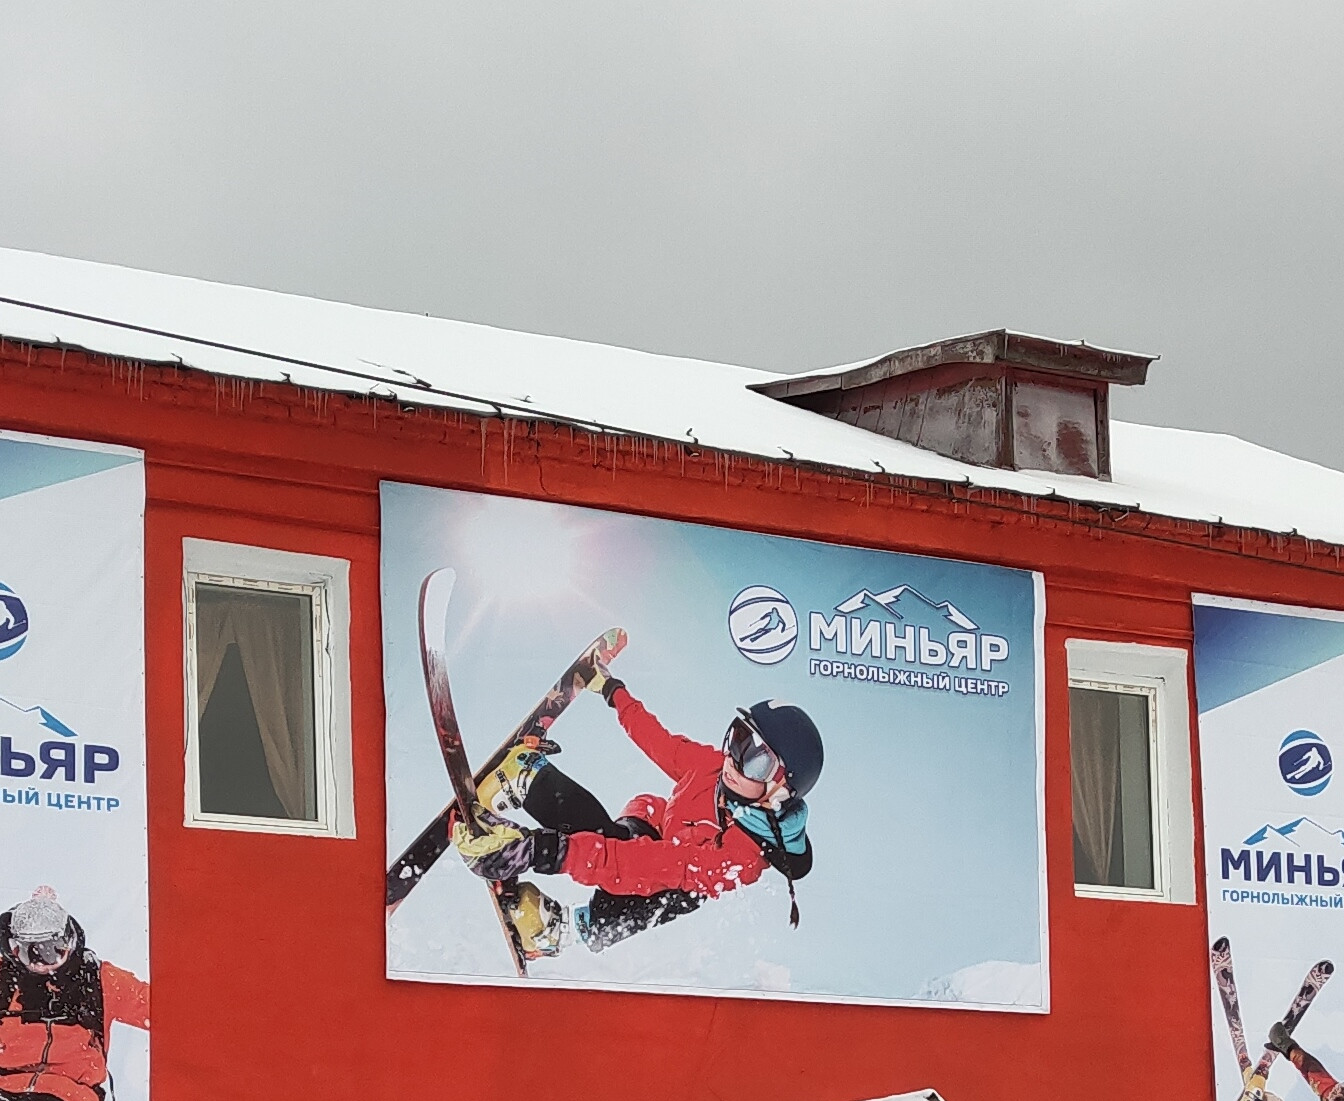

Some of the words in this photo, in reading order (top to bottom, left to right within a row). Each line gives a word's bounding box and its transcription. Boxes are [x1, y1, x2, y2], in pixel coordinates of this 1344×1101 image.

[809, 611, 1009, 671] МИНЬЯР
[810, 659, 950, 690] ГОРНОЛЫЖНЫЙ
[954, 676, 1009, 696] ЦЕНТР
[46, 792, 119, 811] ЦЕНТР
[1222, 889, 1343, 908] ГОРНОЛЫЖНЫЙ
